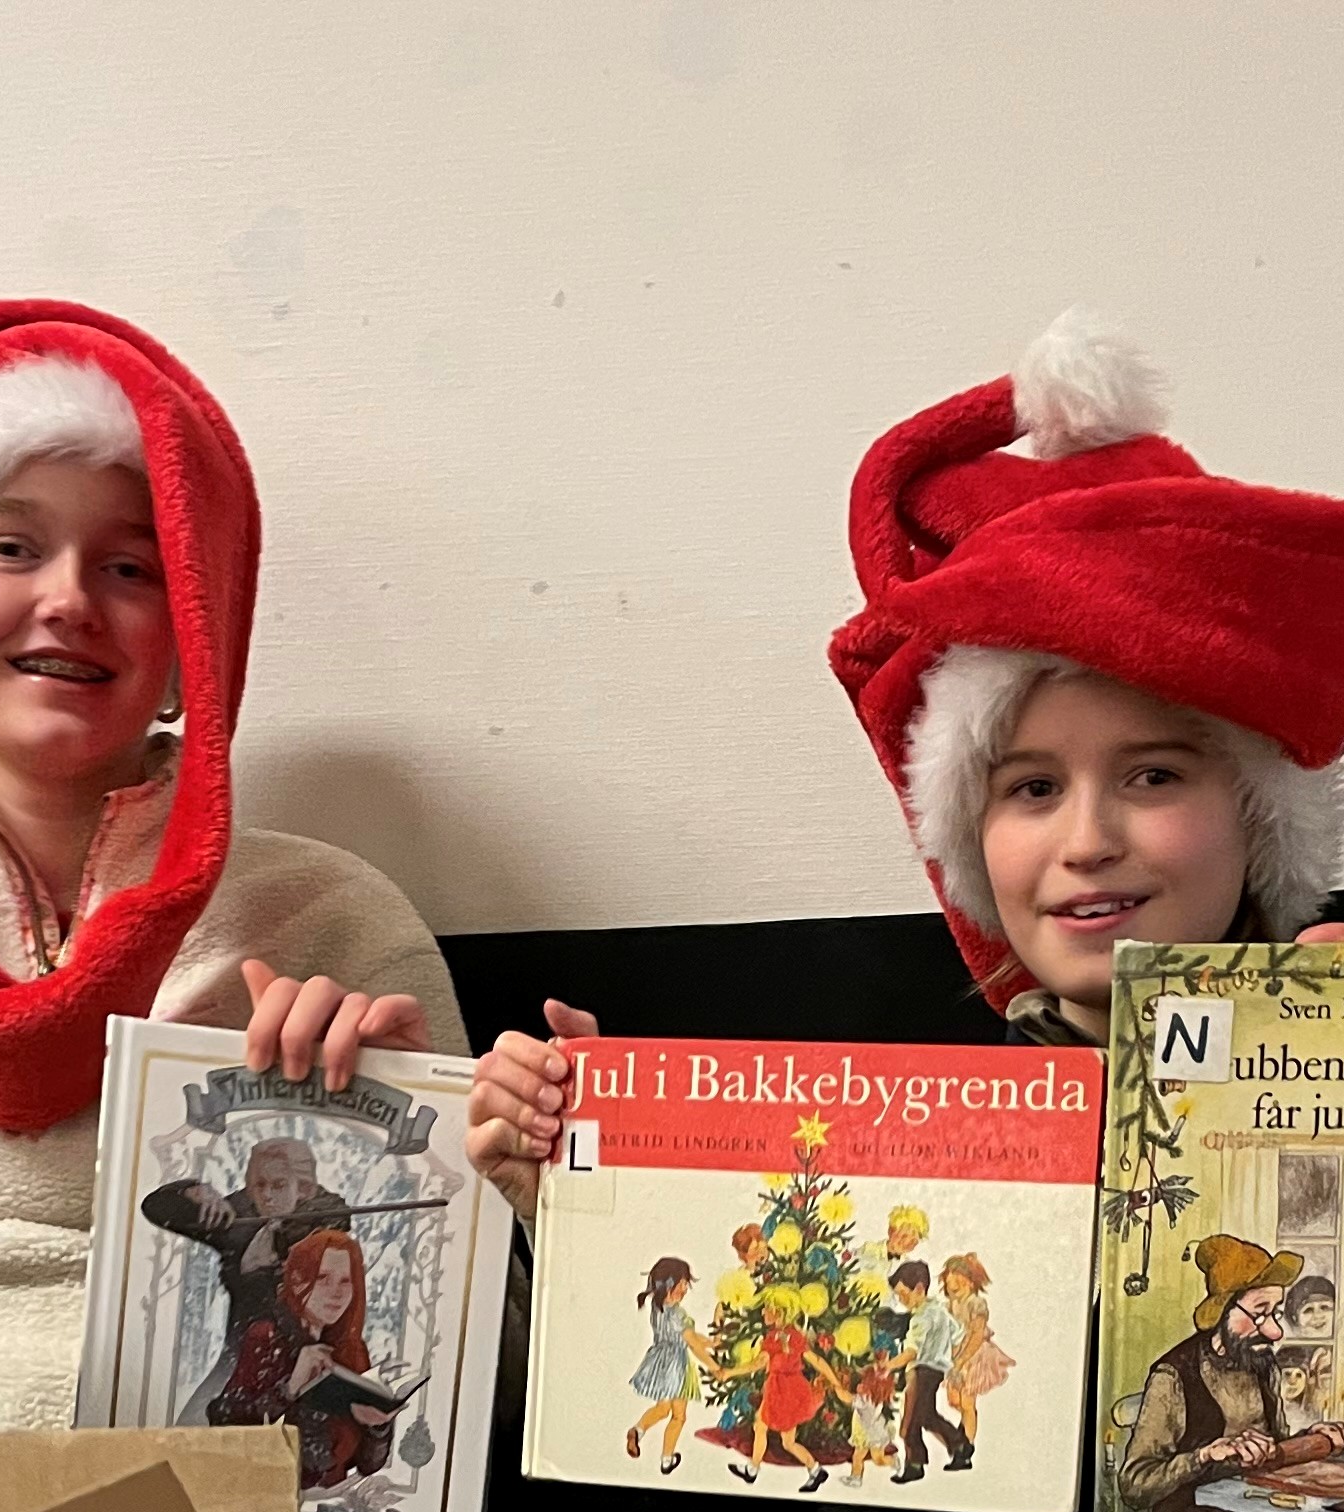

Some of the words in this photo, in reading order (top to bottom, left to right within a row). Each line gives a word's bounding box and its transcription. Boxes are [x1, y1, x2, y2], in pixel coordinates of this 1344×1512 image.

[1278, 996, 1331, 1020] Sven
[1161, 1012, 1210, 1064] N
[1231, 1043, 1344, 1083] ubben
[570, 1050, 637, 1113] Jul
[655, 1051, 668, 1099] i
[687, 1053, 1089, 1126] Bakkebygrenda
[1251, 1093, 1302, 1130] får
[568, 1131, 593, 1172] L
[673, 1135, 767, 1152] LINDGREN
[946, 1144, 1040, 1160] WIKLAND
